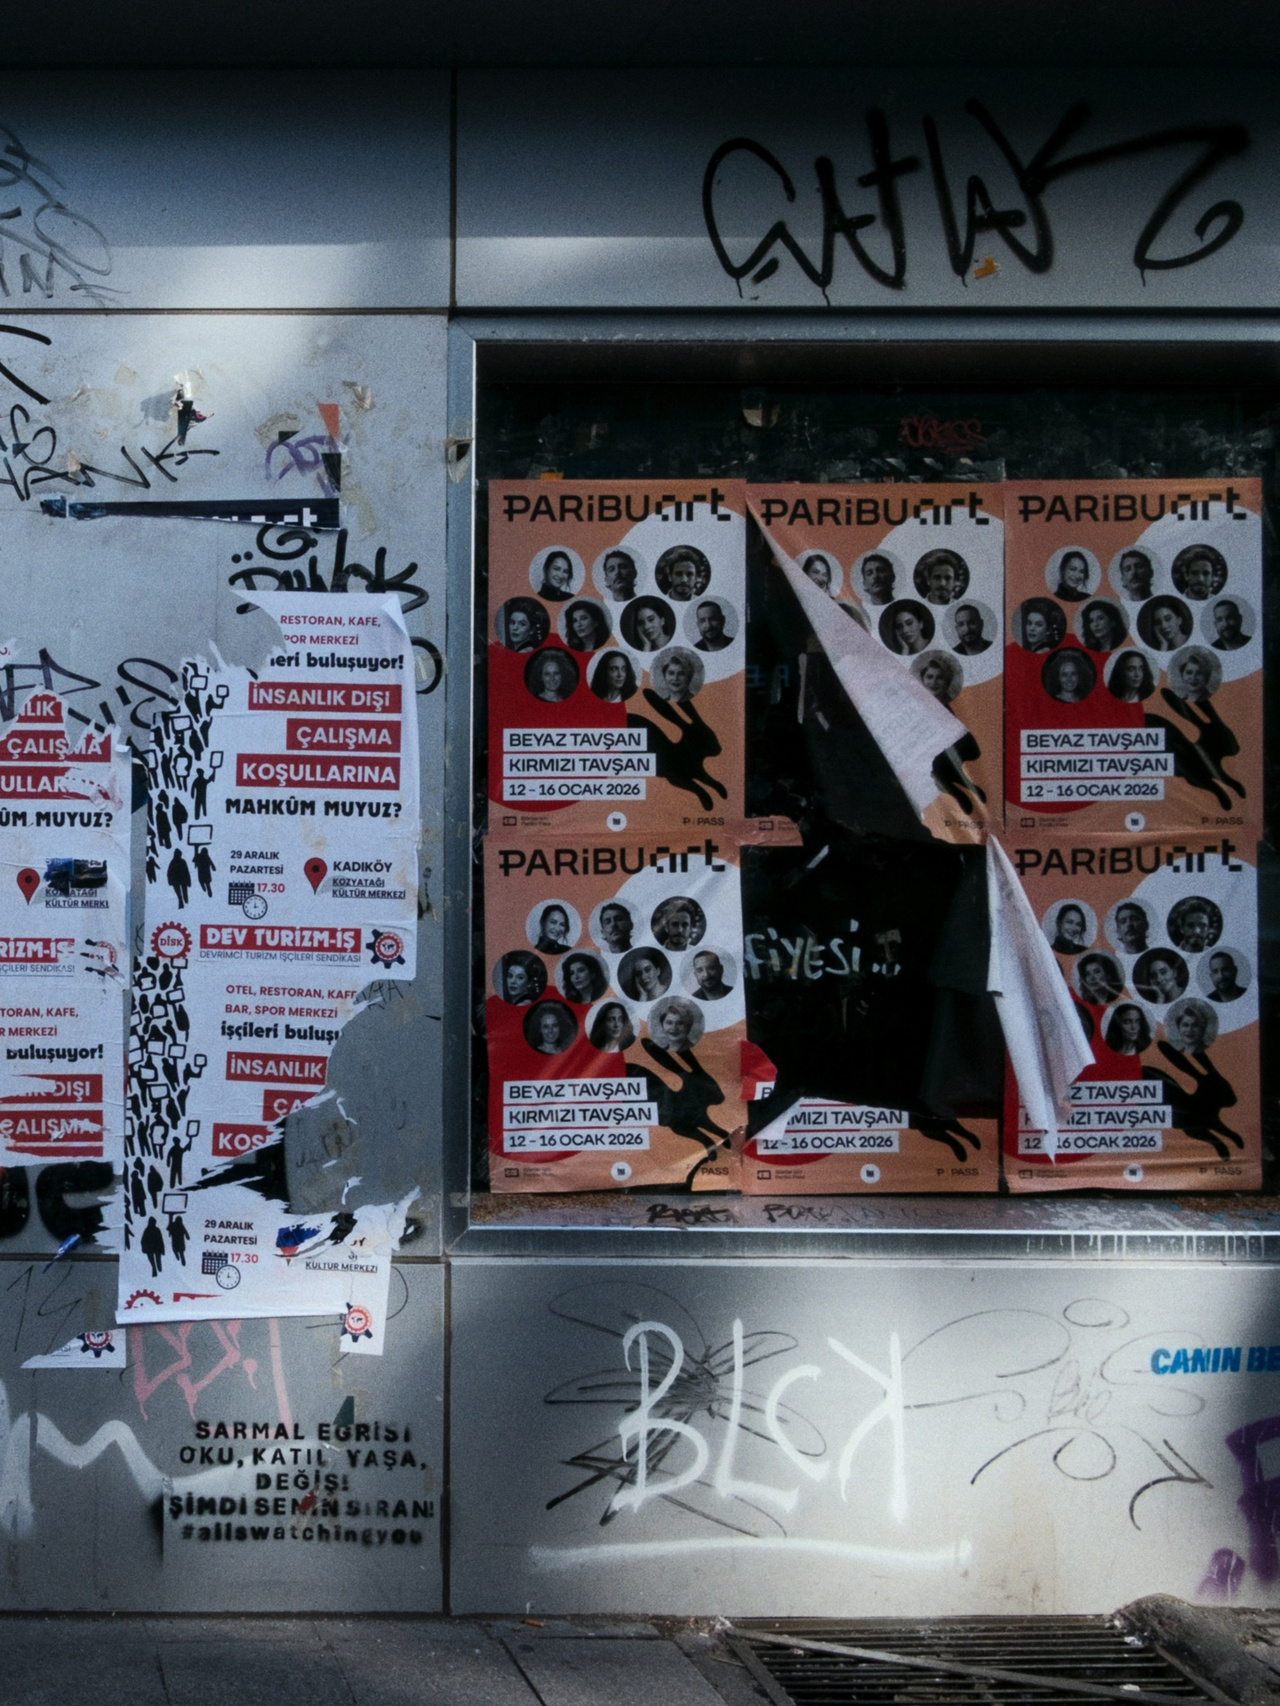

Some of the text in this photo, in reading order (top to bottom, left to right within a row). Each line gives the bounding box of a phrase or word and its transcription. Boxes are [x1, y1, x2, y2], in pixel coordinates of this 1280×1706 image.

[280, 615, 381, 628] RESTORAN, KAFE,
[310, 634, 359, 645] MERKEZİ
[307, 652, 404, 671] buluşuyor!
[253, 684, 345, 705] İNSANLIK
[296, 727, 392, 749] ÇALIŞMA
[509, 733, 641, 751] BEYAZ TAVŞAN
[1026, 732, 1159, 751] BEYAZ TAVŞAN
[242, 762, 396, 786] KOŞULLARINA
[509, 758, 650, 775] KIRMIZI TAVŞAN
[1026, 758, 1168, 776] KIRMIZI TAVŞAN
[509, 783, 640, 796] 12 16 OCAK 2026
[1027, 783, 1158, 797] 12 16 OCAK 2026
[324, 801, 402, 818] MUYUZ?
[35, 811, 113, 828] MUYUZ?
[230, 850, 280, 861] 29 ARALIK
[230, 863, 283, 875] PAZARTESİ
[333, 860, 392, 873] KADIKÖY
[257, 883, 285, 893] 17.30
[332, 887, 406, 899] KÜLTÜR MERKEZİ
[207, 927, 247, 946] DEV
[226, 985, 324, 999] OTEL, RESTORAN,
[46, 1007, 79, 1018] KAFE,
[225, 1004, 338, 1018] BAR, SPOR MERKEZİ
[8, 1025, 57, 1037] MERKEZİ
[221, 1021, 278, 1040] işçileri
[230, 1055, 323, 1079] İNSANLIK
[509, 1082, 640, 1100] BEYAZ TAVŞAN
[1086, 1085, 1157, 1102] TAVŞAN
[509, 1107, 651, 1125] KIRMIZI TAVŞAN
[786, 1110, 903, 1128] MIZI TAVŞAN
[1095, 1110, 1166, 1127] TAVŞAN
[510, 1133, 643, 1147] 12 16 OCAK 2026
[763, 1136, 893, 1149] 12 16 OCAK 2026
[1024, 1137, 1041, 1149] 12
[1073, 1136, 1119, 1148] OCAK
[1122, 1136, 1157, 1148] 2026
[702, 1166, 729, 1176] PASS
[204, 1219, 254, 1231] 29 ARALIK
[204, 1234, 258, 1246] PAZARTESİ
[230, 1253, 259, 1264] 17.30
[1150, 1346, 1280, 1375] CANIN BE
[195, 1421, 305, 1439] SARMAL
[179, 1446, 244, 1468] OKU,
